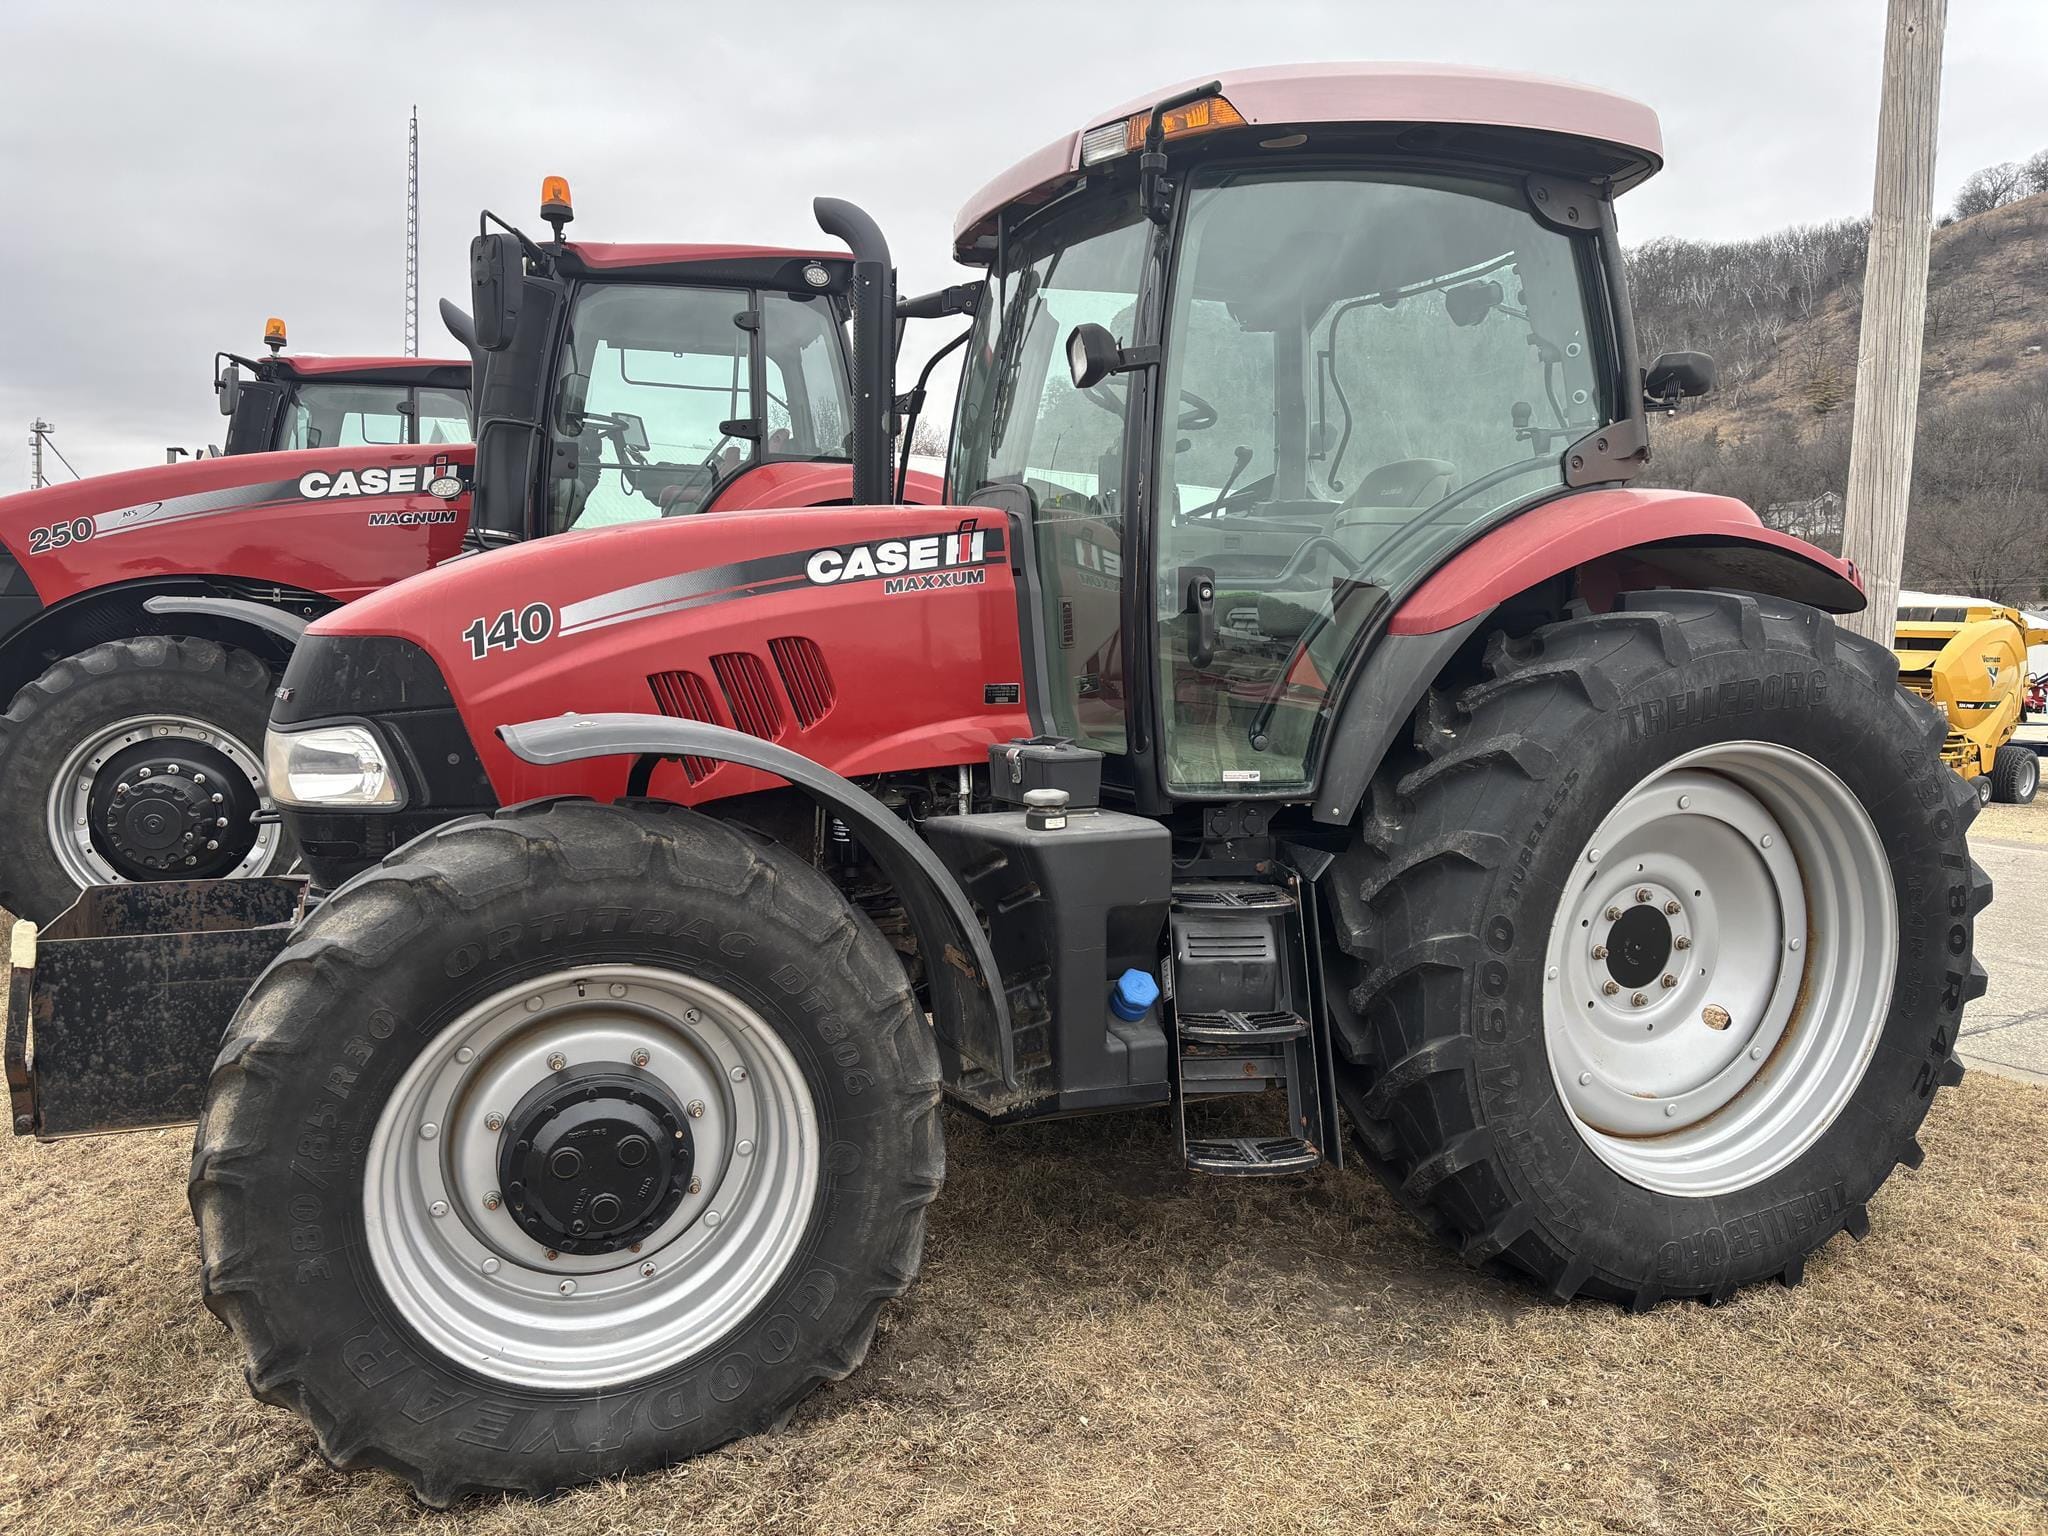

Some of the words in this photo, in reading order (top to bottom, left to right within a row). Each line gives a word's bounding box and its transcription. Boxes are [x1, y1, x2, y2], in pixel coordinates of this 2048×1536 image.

[299, 468, 417, 498] CASE
[28, 516, 94, 555] 250
[122, 509, 138, 518] AFS
[368, 511, 457, 527] MAGNUM
[805, 538, 941, 586] CASE
[884, 568, 986, 596] MAXXUM
[461, 602, 553, 661] 140
[1617, 669, 1831, 745] TRELLEBORG
[1506, 767, 1580, 900] TUBELESS
[443, 906, 761, 979] OPTITRAC
[768, 963, 875, 1097] DT806
[1656, 1181, 1850, 1279] TRELLEBORG
